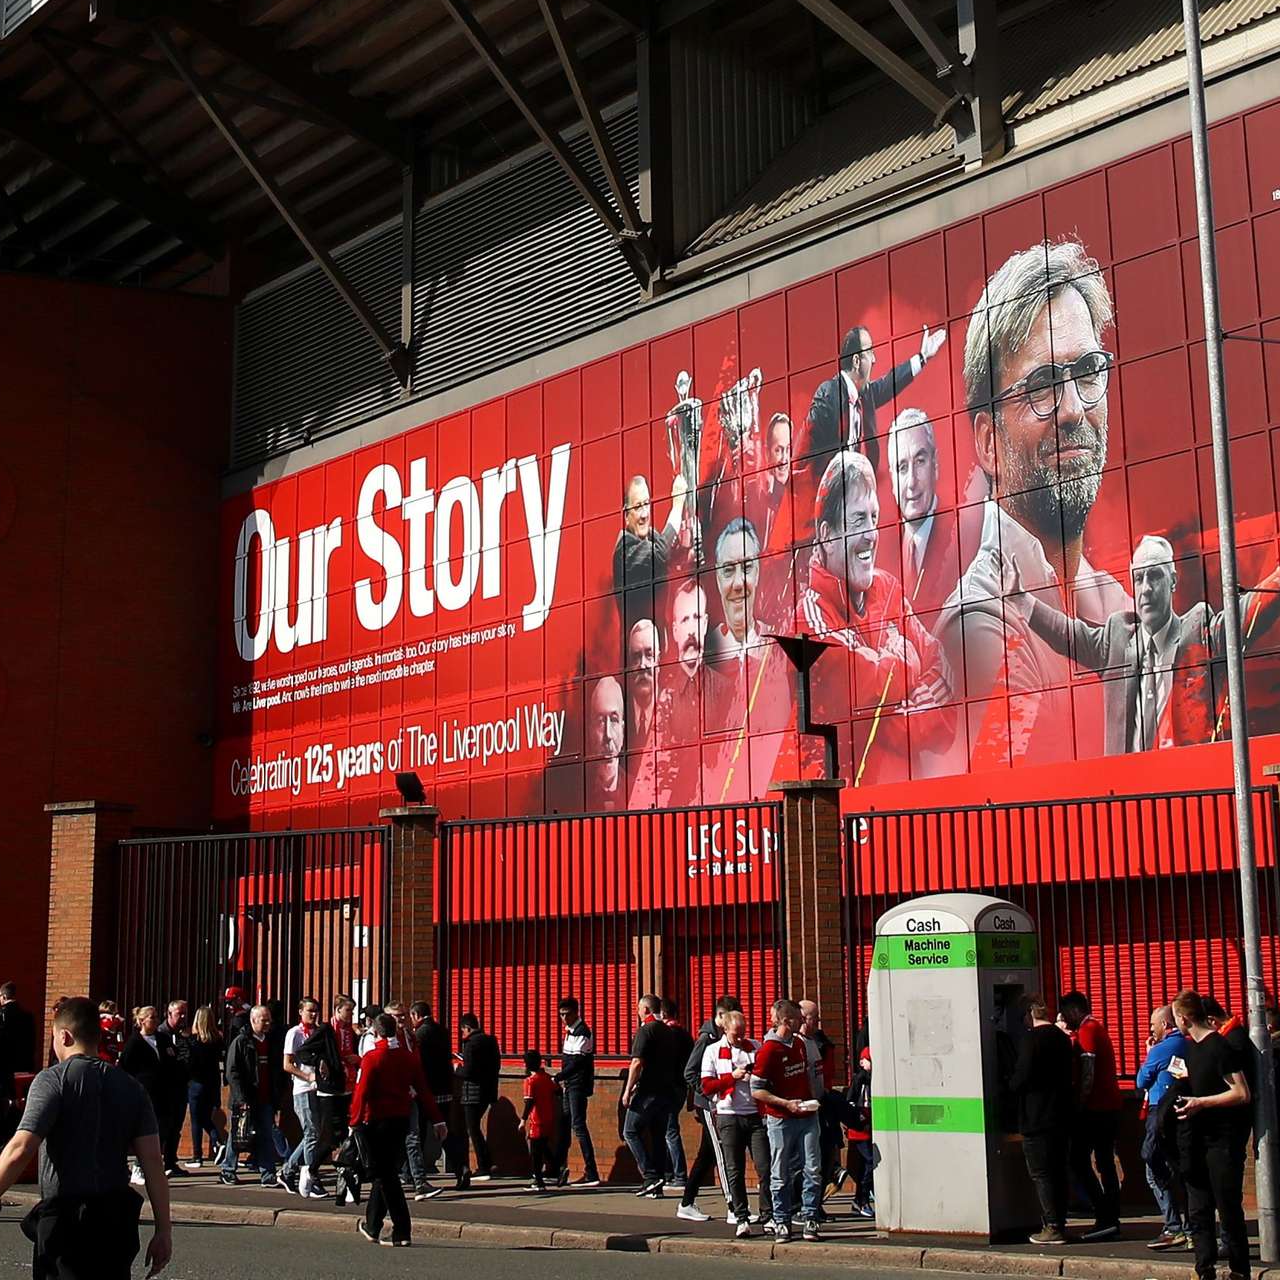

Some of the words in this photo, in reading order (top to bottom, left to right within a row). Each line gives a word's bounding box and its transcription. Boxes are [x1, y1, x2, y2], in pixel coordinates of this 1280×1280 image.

[233, 508, 342, 662] Our
[354, 442, 572, 632] Story
[418, 640, 431, 656] Our
[449, 634, 462, 649] has
[480, 627, 497, 645] your
[230, 748, 302, 797] Celebrating
[303, 742, 333, 785] 125
[336, 740, 384, 789] years
[387, 727, 404, 771] of
[406, 725, 437, 769] The
[442, 706, 520, 767] Liverpool
[524, 702, 565, 756] Way
[687, 822, 728, 861] LFC
[906, 917, 941, 933] Cash
[993, 915, 1015, 931] Cash
[904, 938, 951, 951] Machine
[907, 953, 949, 966] Service
